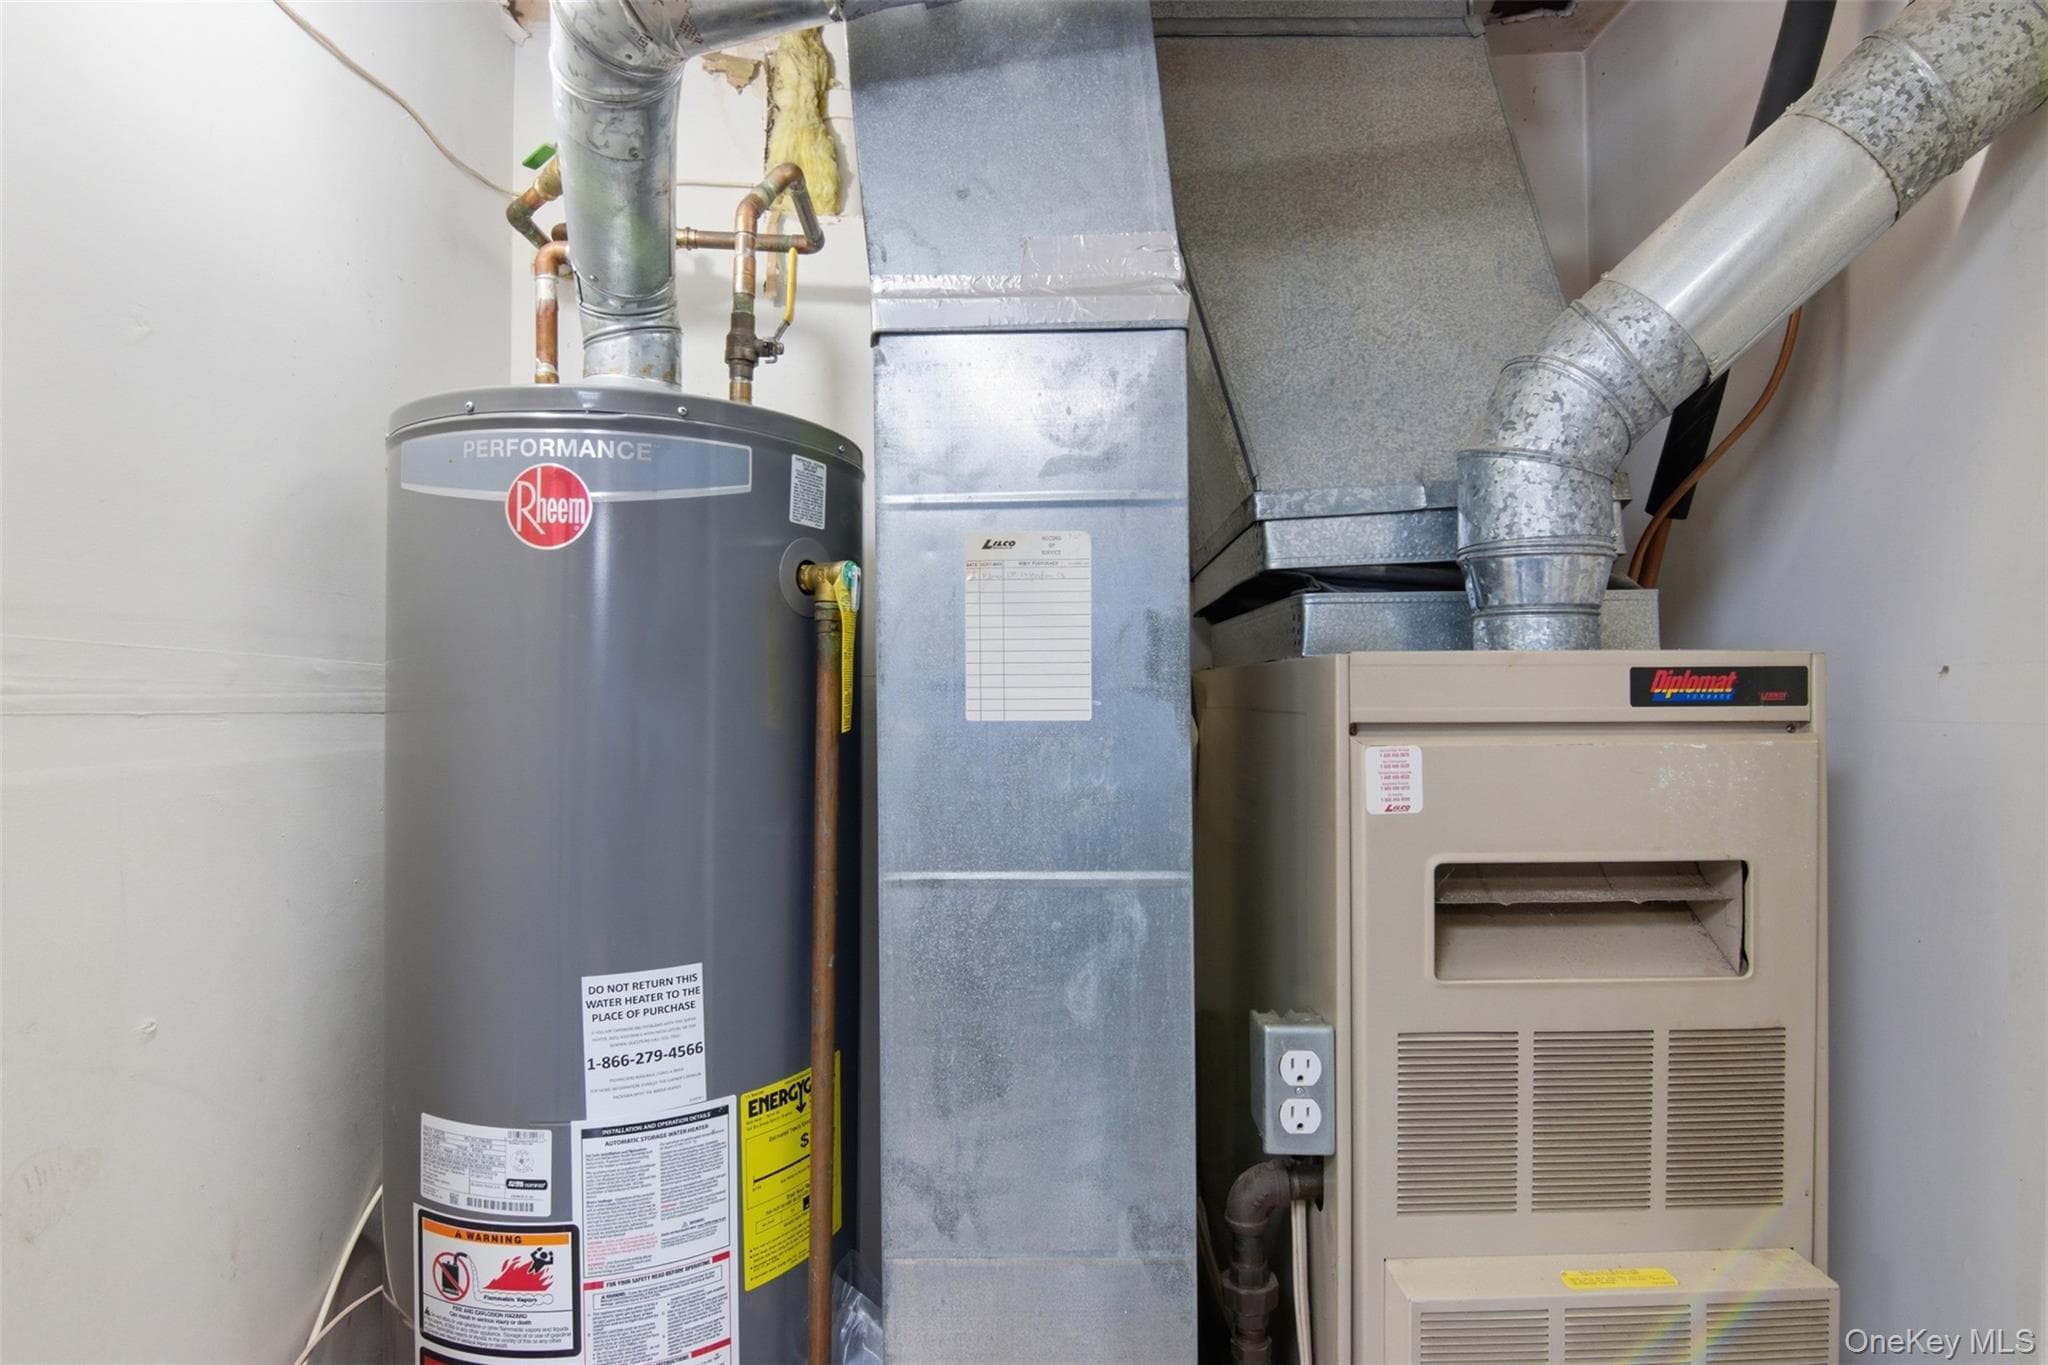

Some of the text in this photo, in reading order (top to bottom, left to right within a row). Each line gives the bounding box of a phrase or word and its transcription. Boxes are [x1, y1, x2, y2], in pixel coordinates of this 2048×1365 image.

[463, 438, 652, 461] PERFORMANCE
[516, 467, 586, 535] Rheem
[1650, 669, 1737, 699] Diplomat
[588, 973, 698, 995] DO NOT RETURN THIS
[586, 986, 701, 1009] WATER HEATER TO THE
[592, 1000, 696, 1022] PLACE OF PURCHASE
[587, 1041, 704, 1070] 1-866-279-4566
[602, 1124, 643, 1136] INSTALLATION
[644, 1122, 657, 1130] AND
[657, 1117, 689, 1128] OPERATION
[605, 1137, 639, 1147] AUTOMATIC
[640, 1133, 667, 1142] STORAGE
[466, 1231, 522, 1245] WARNING
